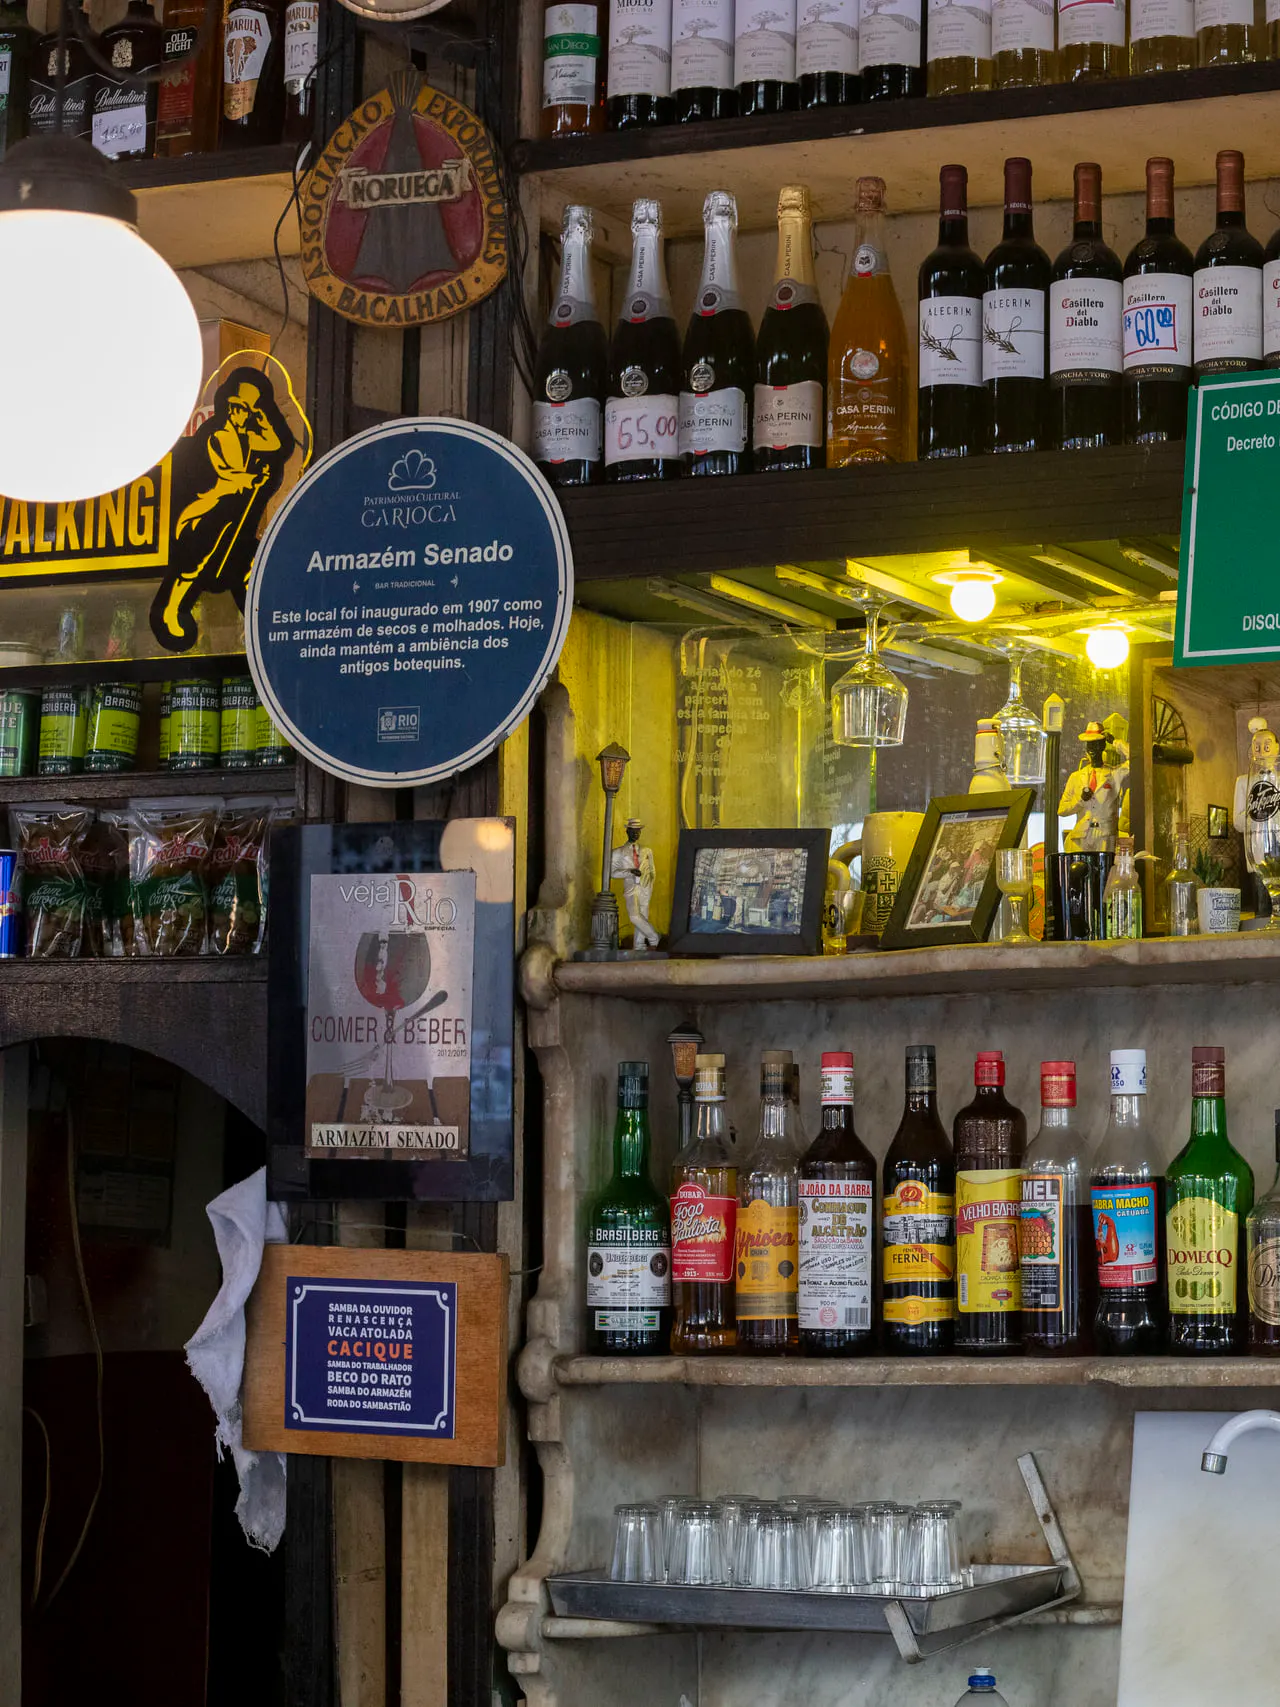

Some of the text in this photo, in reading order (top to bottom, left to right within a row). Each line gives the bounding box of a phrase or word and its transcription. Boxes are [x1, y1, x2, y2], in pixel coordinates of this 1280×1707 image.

[171, 32, 188, 42] OLD
[165, 39, 192, 52] EIGHT
[303, 101, 382, 281] ASSOCIAÇÃO
[353, 174, 454, 201] NORUEGA
[336, 278, 468, 323] BACALHAU
[989, 299, 1031, 309] ALECRIM
[1062, 297, 1104, 310] Casillero
[1066, 316, 1098, 327] Diablo
[837, 405, 896, 414] CASA PERINI
[1211, 400, 1264, 421] CÓDIGO
[1227, 435, 1275, 451] Decreto
[364, 491, 460, 505] PATRIMÔNIO CULTURAL
[0, 476, 154, 555] ALKING
[361, 504, 457, 529] CARIOCA
[307, 540, 513, 572] Armazém Senado
[390, 580, 435, 588] TRADICIONAL
[272, 600, 542, 623] Este local foi inaugurado em 1907 como
[268, 616, 544, 641] um armazém de secos e molhados. Hoje,
[300, 636, 508, 658] ainda mantém a ambiência dos
[340, 656, 465, 675] antigos botequins.
[339, 879, 456, 926] veja Rio
[312, 1016, 377, 1043] COMER
[383, 1020, 396, 1044] &
[316, 1126, 455, 1149] ARMAZÉM SENADO
[1023, 1181, 1057, 1200] MEL
[1116, 1197, 1149, 1208] MACHO
[674, 1202, 704, 1226] Fogo
[962, 1206, 990, 1221] VELHO
[1117, 1209, 1149, 1217] CATUABA
[596, 1228, 658, 1241] BRASILBERG
[672, 1217, 721, 1248] Paulista
[893, 1253, 933, 1264] FERNET
[1168, 1248, 1232, 1268] DOMECQ
[329, 1303, 412, 1315] SAMBA DA OUVIDOR
[329, 1314, 412, 1328] RENASCENÇA
[328, 1326, 412, 1340] VACA ATOLADA
[328, 1340, 413, 1361] CACIQUE
[328, 1360, 412, 1371] SAMBA DO TRABALHADOR
[328, 1371, 411, 1386] BECO DO RATO
[328, 1386, 411, 1398] SAMBA DO ARMAZÉM
[327, 1399, 411, 1411] RODA DO SAMBASTIÃO
